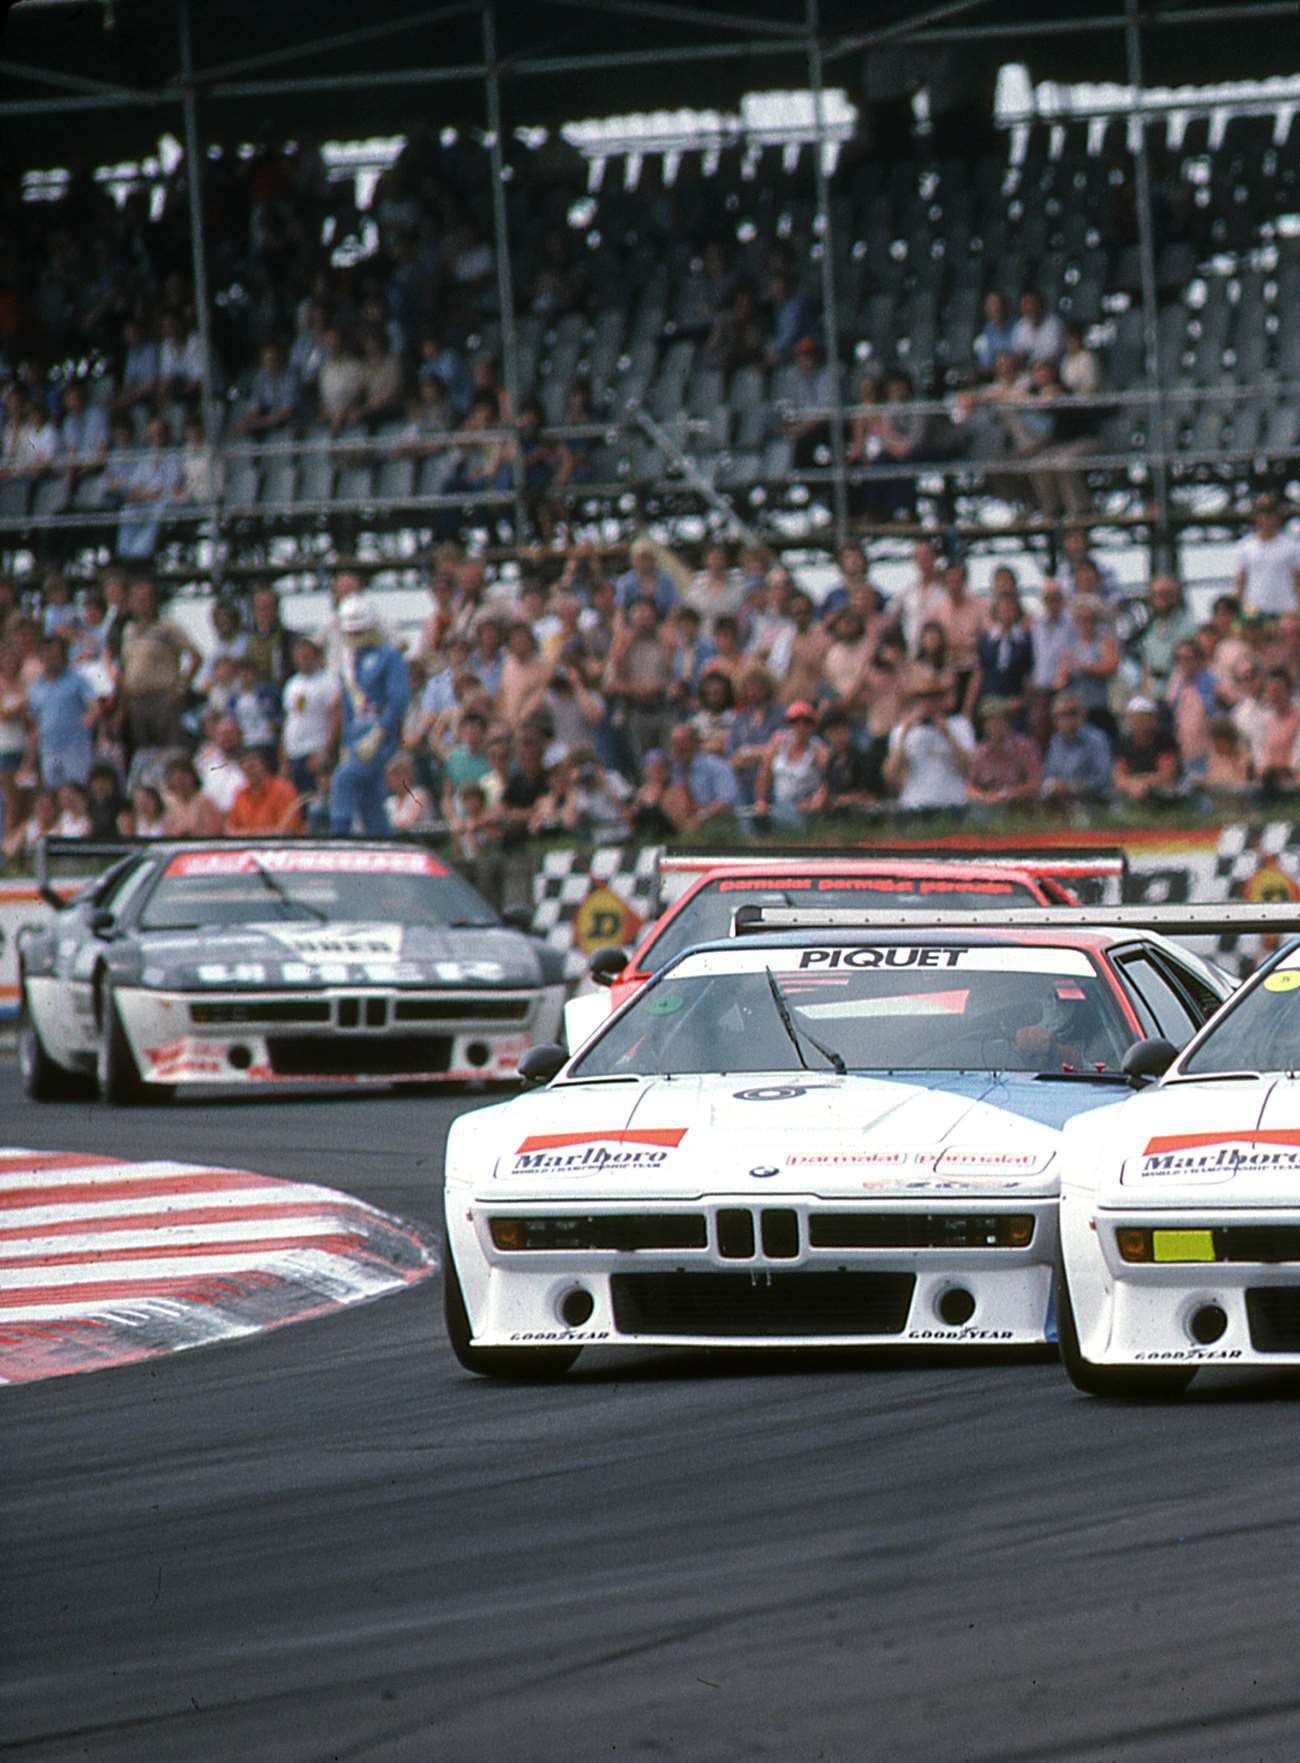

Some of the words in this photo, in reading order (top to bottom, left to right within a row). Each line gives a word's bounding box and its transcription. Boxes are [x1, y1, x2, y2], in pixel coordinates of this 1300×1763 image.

[799, 949, 968, 969] PIQUET
[515, 1148, 667, 1169] Marlboro
[791, 1153, 899, 1165] parmalat
